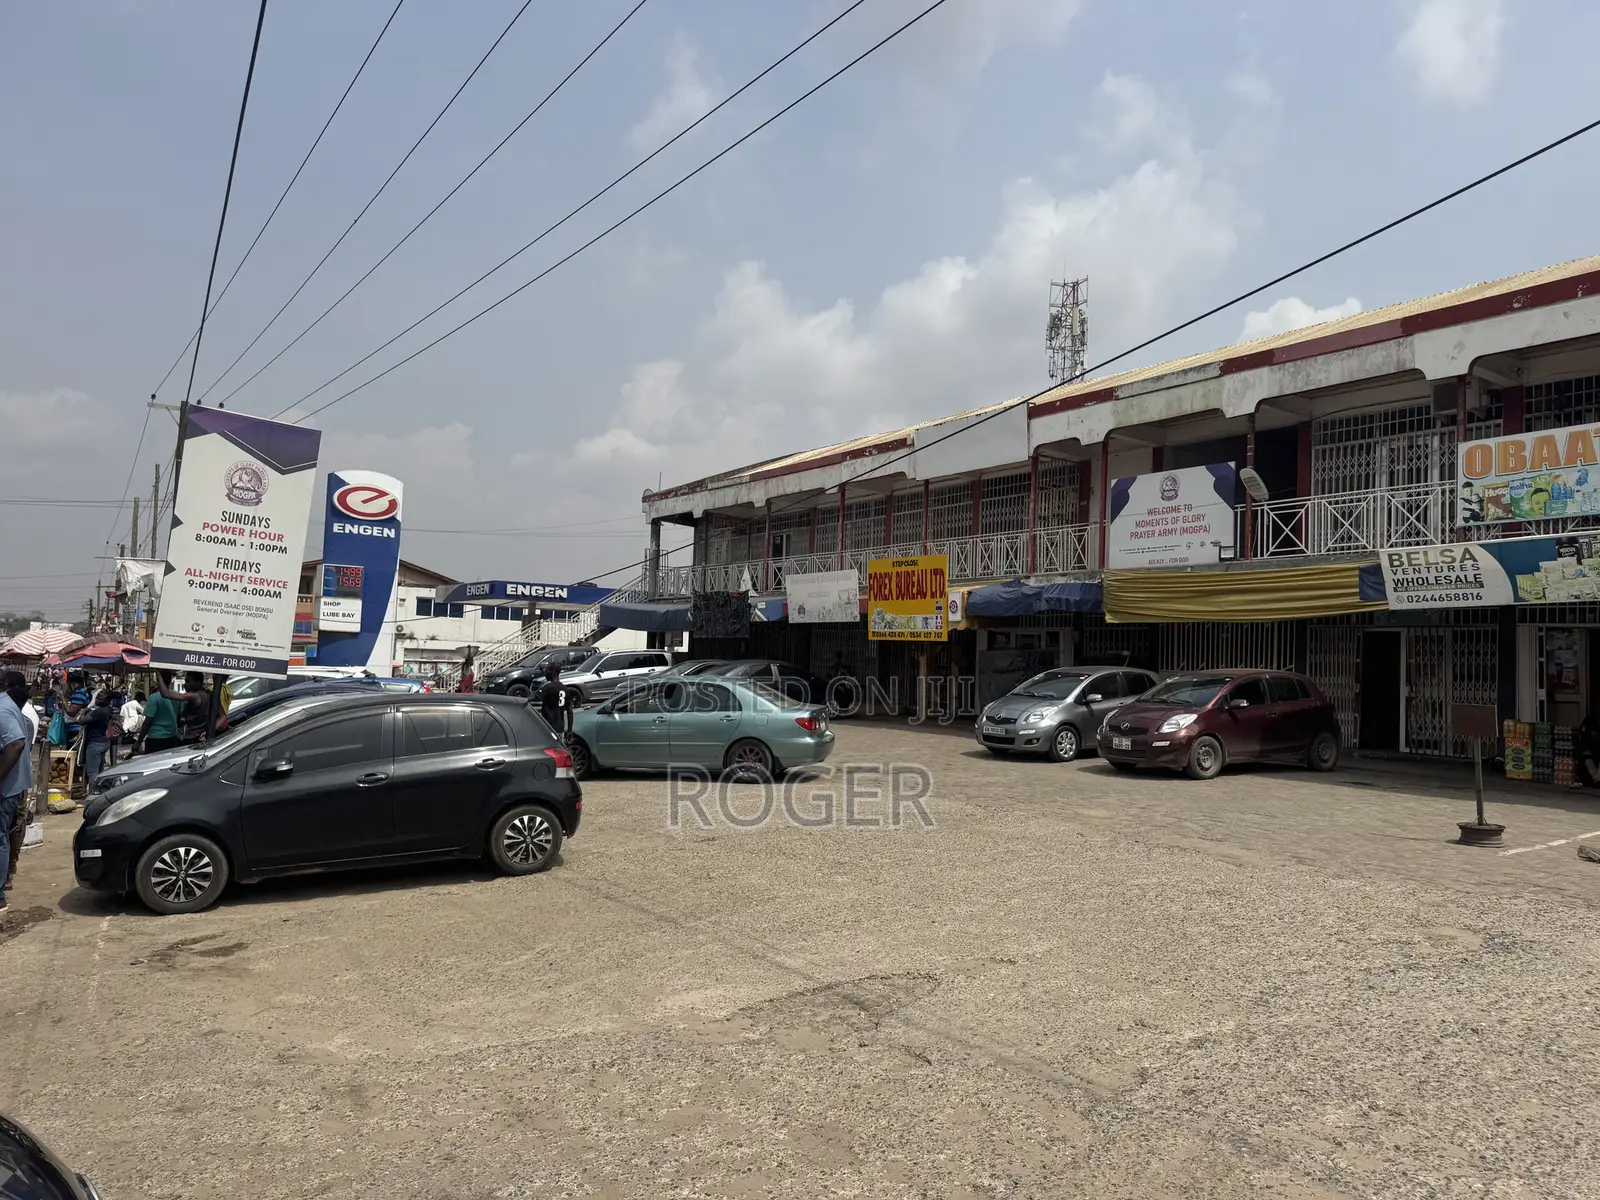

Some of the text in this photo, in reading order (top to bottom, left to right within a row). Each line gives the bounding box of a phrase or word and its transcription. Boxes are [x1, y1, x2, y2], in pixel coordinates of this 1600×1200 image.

[1147, 504, 1193, 517] WELCOME TO
[220, 510, 271, 529] SUNDAYS
[1135, 513, 1206, 529] MOMENTS OF GLORY
[202, 522, 284, 543] POWER HOUR
[333, 523, 395, 538] ENGEN
[1130, 524, 1211, 540] PRAYER ARMY (MOGPA)
[195, 534, 237, 547] 8:00AM
[249, 542, 288, 555] 1:00PM
[1387, 547, 1479, 568] BELSA
[216, 557, 261, 574] FRIDAYS
[1390, 563, 1480, 576] VENTURES
[184, 567, 288, 589] ALL-NIGHT SERVICE
[868, 568, 947, 601] FOREX BUREAU LTD.
[1392, 573, 1483, 588] WHOLESALE
[188, 579, 229, 593] 9:00PM
[240, 586, 282, 599] 4:00AM
[466, 584, 490, 596] ENGEN
[506, 584, 568, 599] ENGEN
[1406, 592, 1483, 604] 0244658816
[193, 599, 274, 614] REVEREND ISAAC OSEI BONSU
[196, 606, 269, 620] General Overseer (MOGPA)
[223, 657, 238, 668] FOR
[239, 658, 256, 669] GOD
